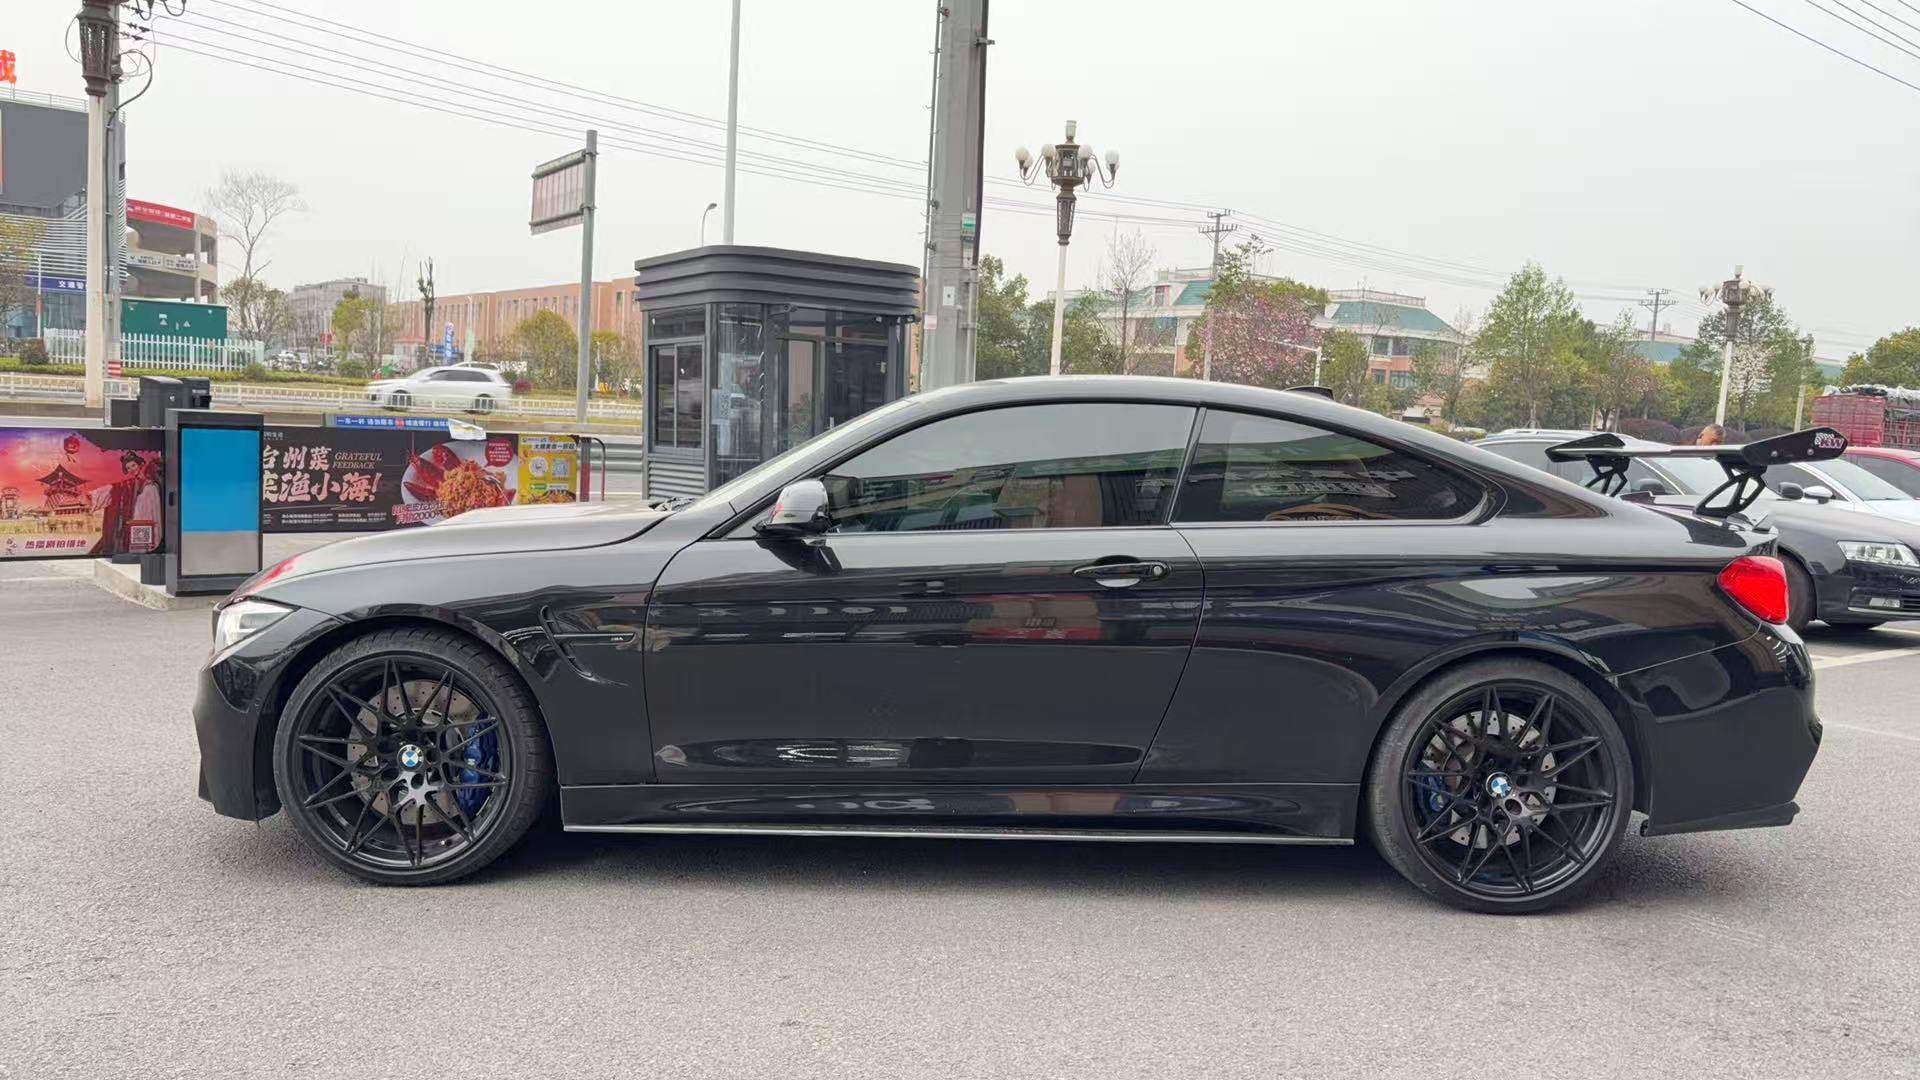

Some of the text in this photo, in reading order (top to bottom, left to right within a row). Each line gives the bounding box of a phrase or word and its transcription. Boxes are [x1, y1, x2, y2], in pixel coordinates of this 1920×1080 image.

[58, 280, 87, 290] 交通警
[334, 452, 382, 461] GRATEFUL
[333, 461, 375, 470] FEEDBACK
